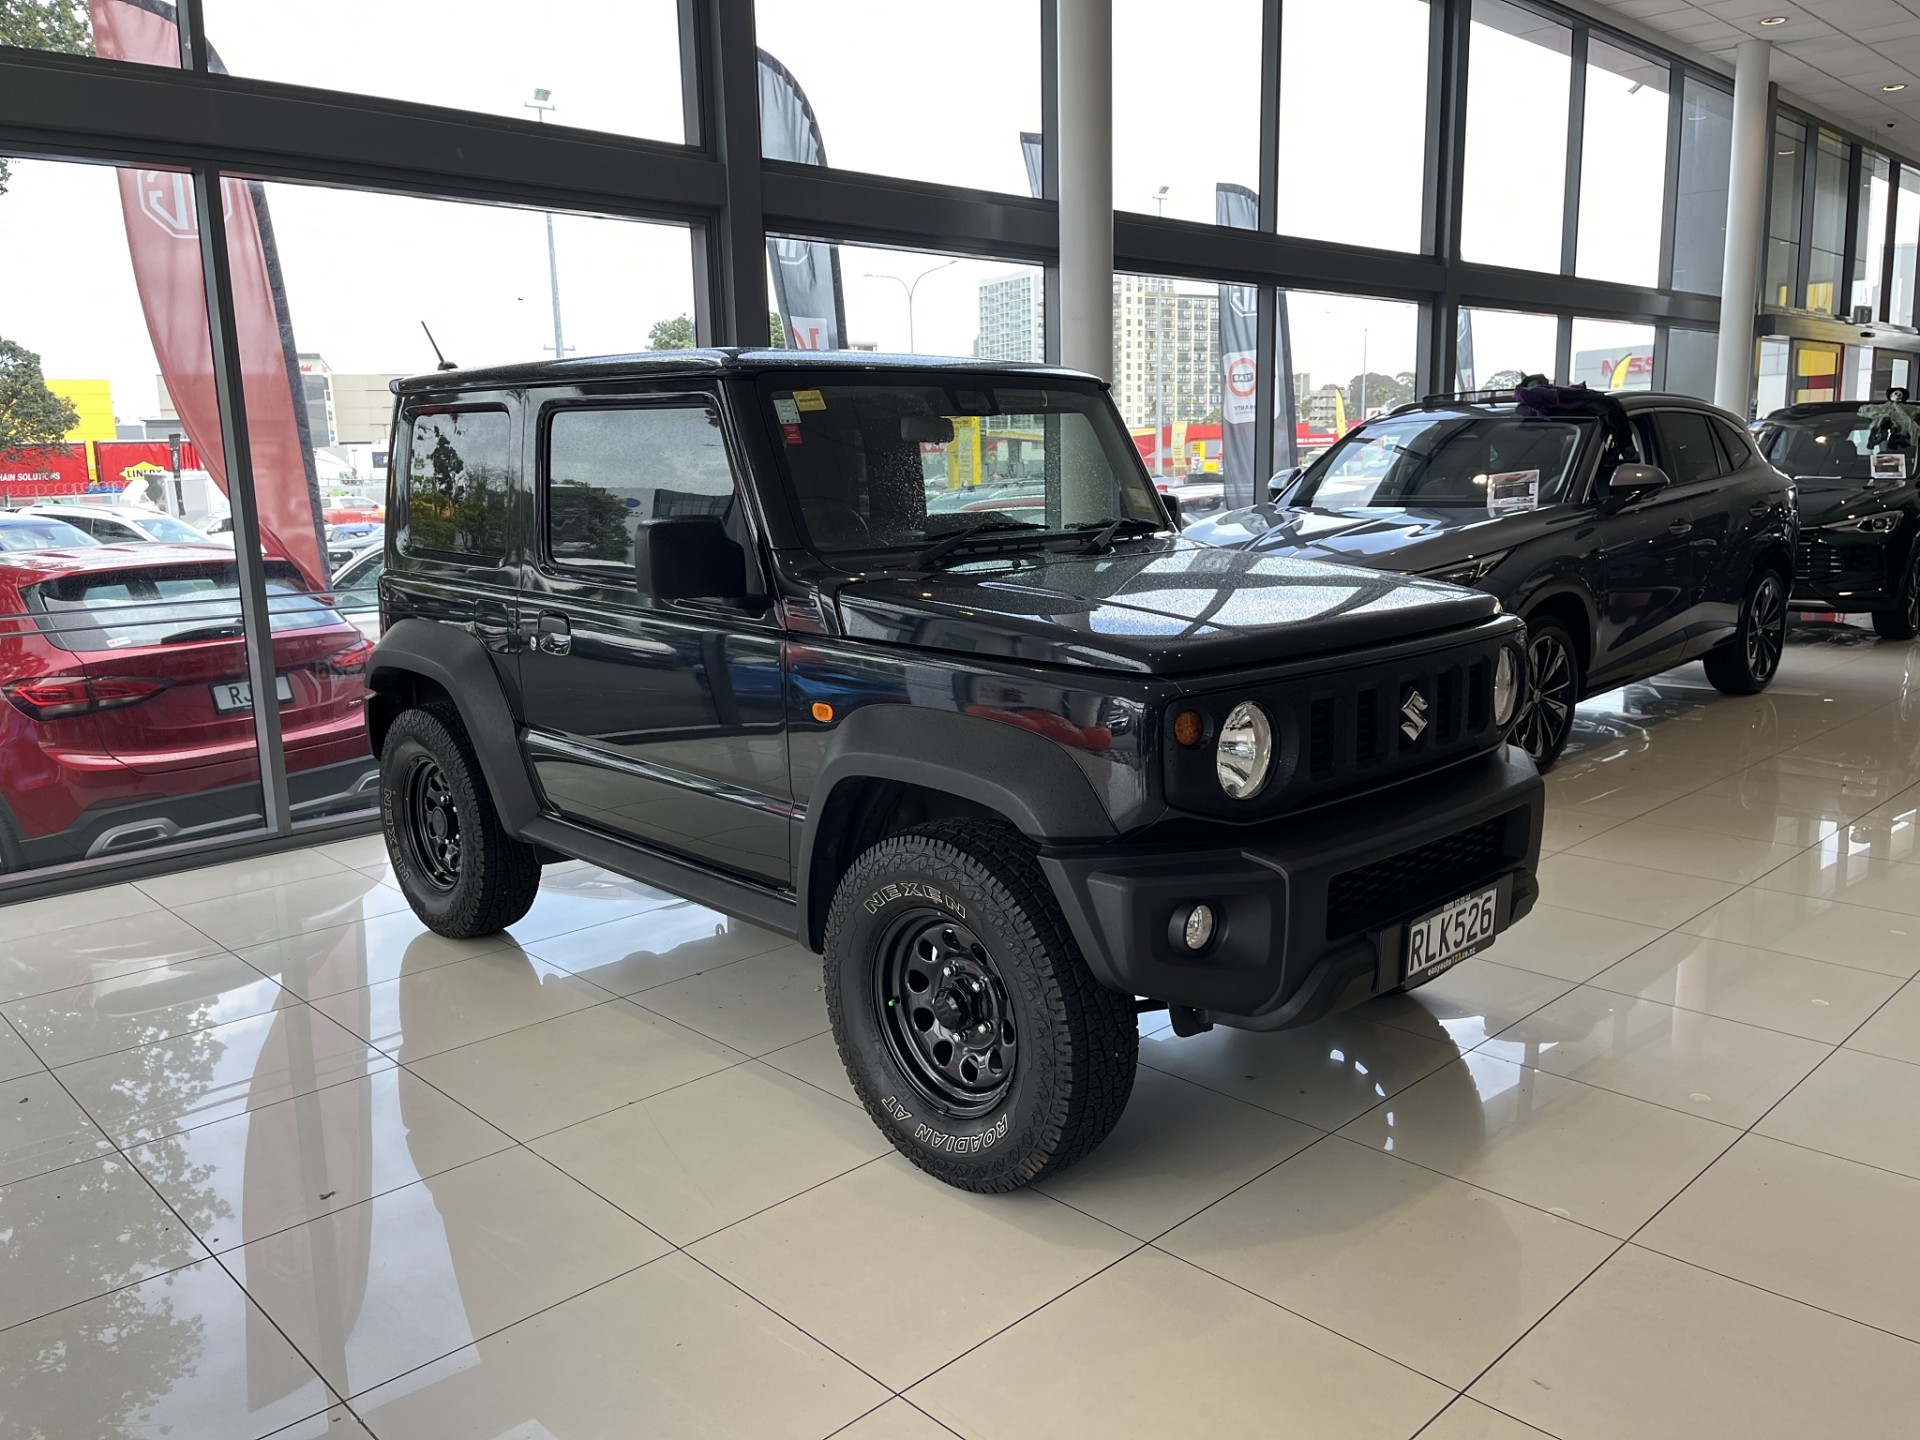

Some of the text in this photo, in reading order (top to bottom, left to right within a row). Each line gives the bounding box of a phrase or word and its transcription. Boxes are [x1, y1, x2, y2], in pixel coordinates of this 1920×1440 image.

[863, 881, 967, 919] NEXEN
[1410, 896, 1492, 972] RLK526
[1427, 946, 1476, 975] easyauto123.co.nz
[881, 1095, 1009, 1154] ROADIAN AT
